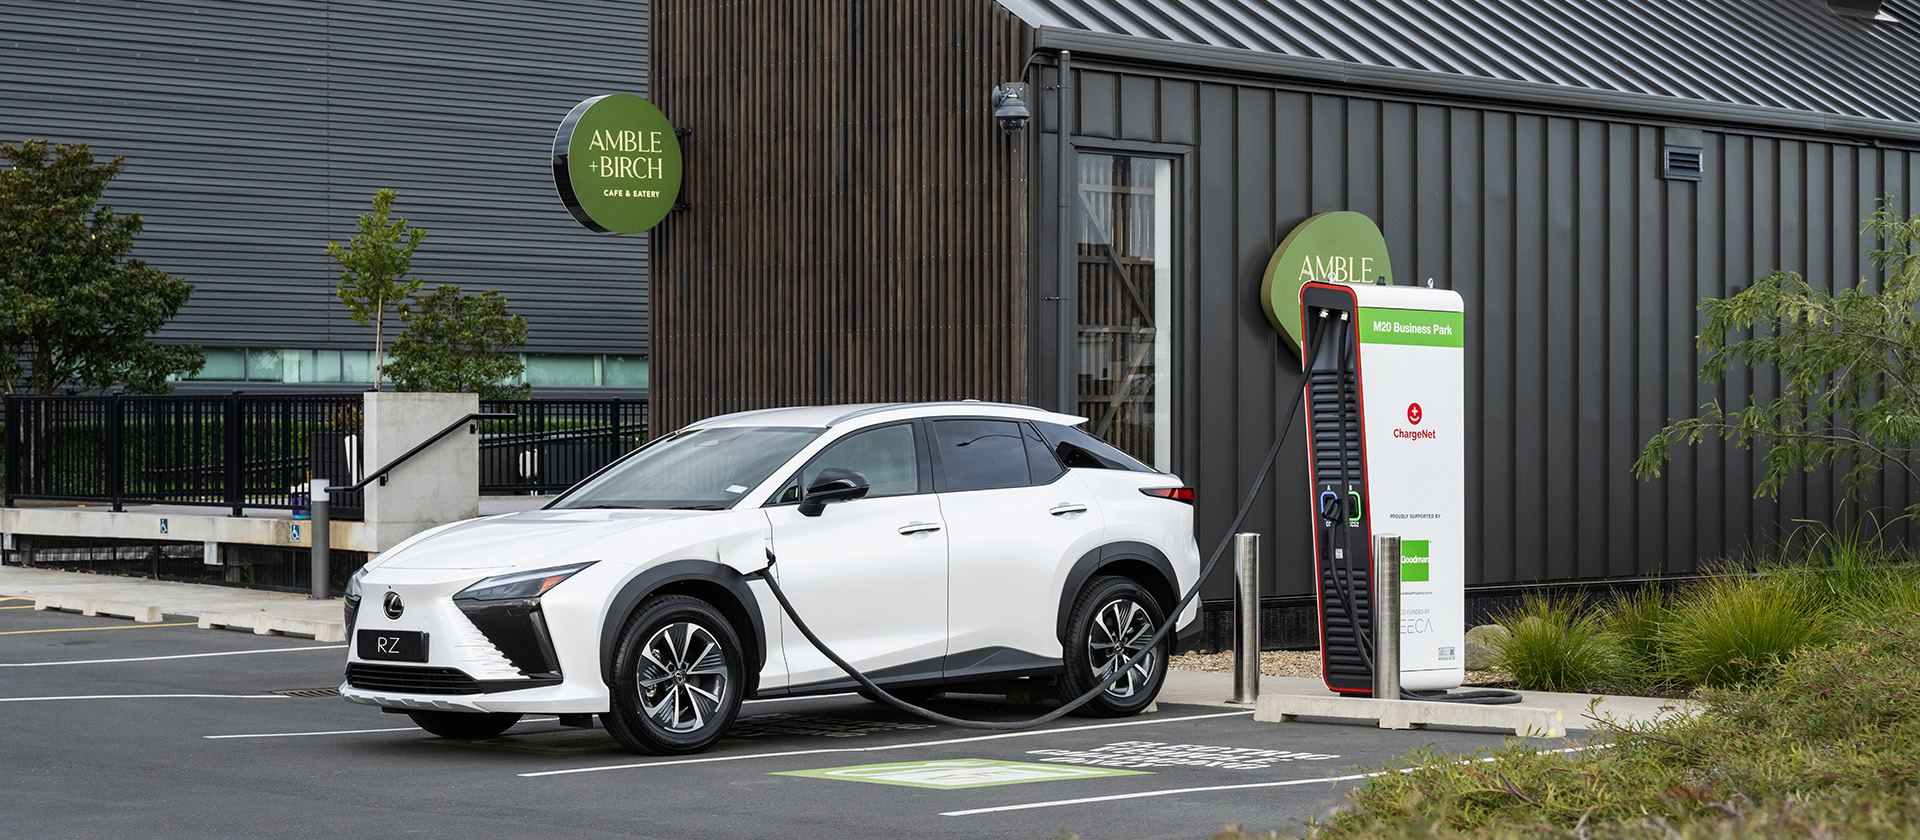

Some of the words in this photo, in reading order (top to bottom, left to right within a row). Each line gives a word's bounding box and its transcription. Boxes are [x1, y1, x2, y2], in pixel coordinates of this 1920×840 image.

[589, 129, 662, 153] AMBLE
[589, 156, 662, 179] +BIRCH
[603, 189, 623, 197] CAFE
[633, 190, 660, 198] EATERY
[1298, 255, 1374, 283] AMBLE
[1373, 321, 1392, 332] M20
[1393, 322, 1432, 335] Business
[1433, 324, 1453, 335] Park
[1393, 428, 1436, 441] ChargeNet
[1401, 555, 1430, 564] Goodman
[377, 636, 400, 653] RZ
